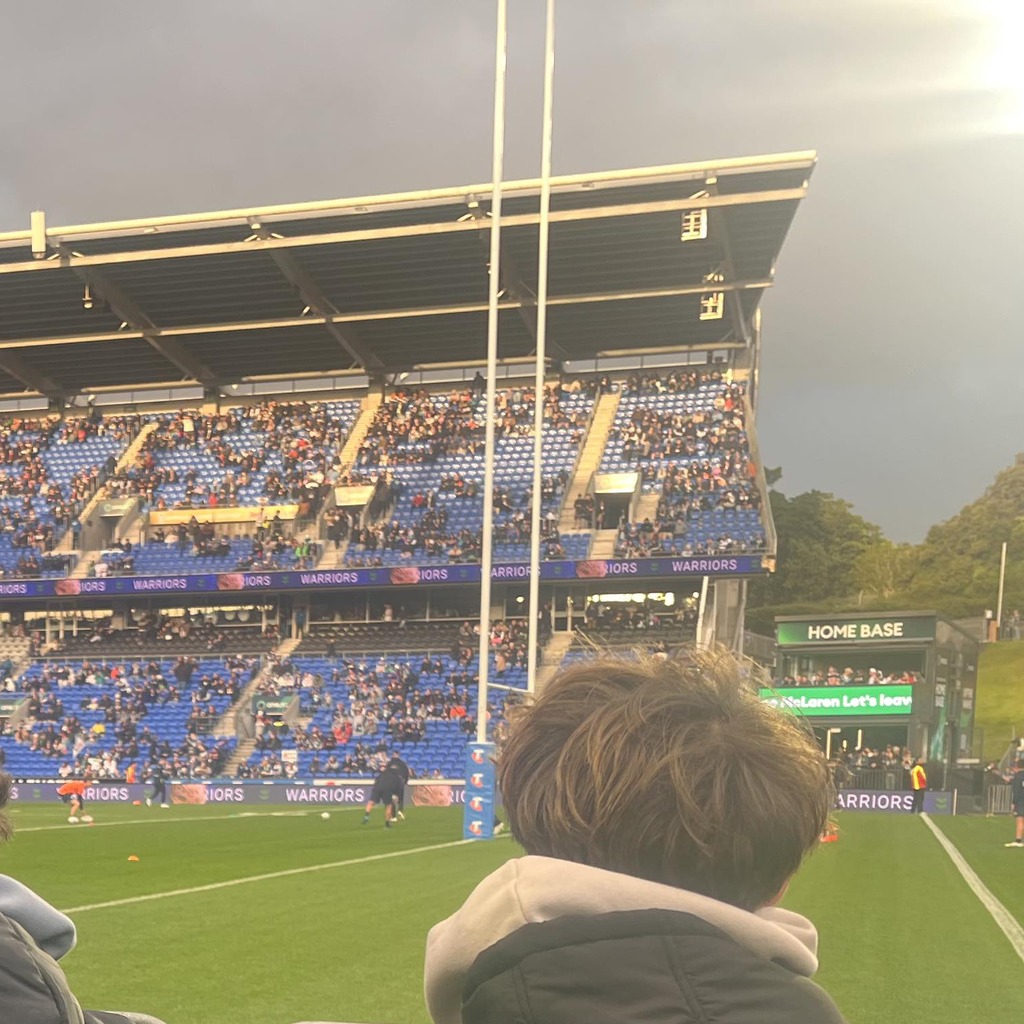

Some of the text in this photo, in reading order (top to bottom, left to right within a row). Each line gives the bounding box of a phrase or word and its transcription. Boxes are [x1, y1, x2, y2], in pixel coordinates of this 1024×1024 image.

[480, 565, 541, 579] ARRIOR
[606, 561, 638, 574] RIORS
[672, 559, 737, 572] WARRIORS
[300, 572, 358, 585] WARRIORS
[418, 568, 449, 580] IORS
[80, 581, 106, 592] IORS
[132, 578, 188, 591] WARRIORS
[244, 575, 272, 587] IORS
[808, 622, 904, 640] HOME BASE
[843, 694, 878, 707] Let's
[880, 692, 912, 706] leav
[80, 787, 130, 801] RIORS
[204, 787, 245, 803] RIORS
[286, 788, 366, 803] WARRIORS
[836, 794, 914, 810] ARRIORS
